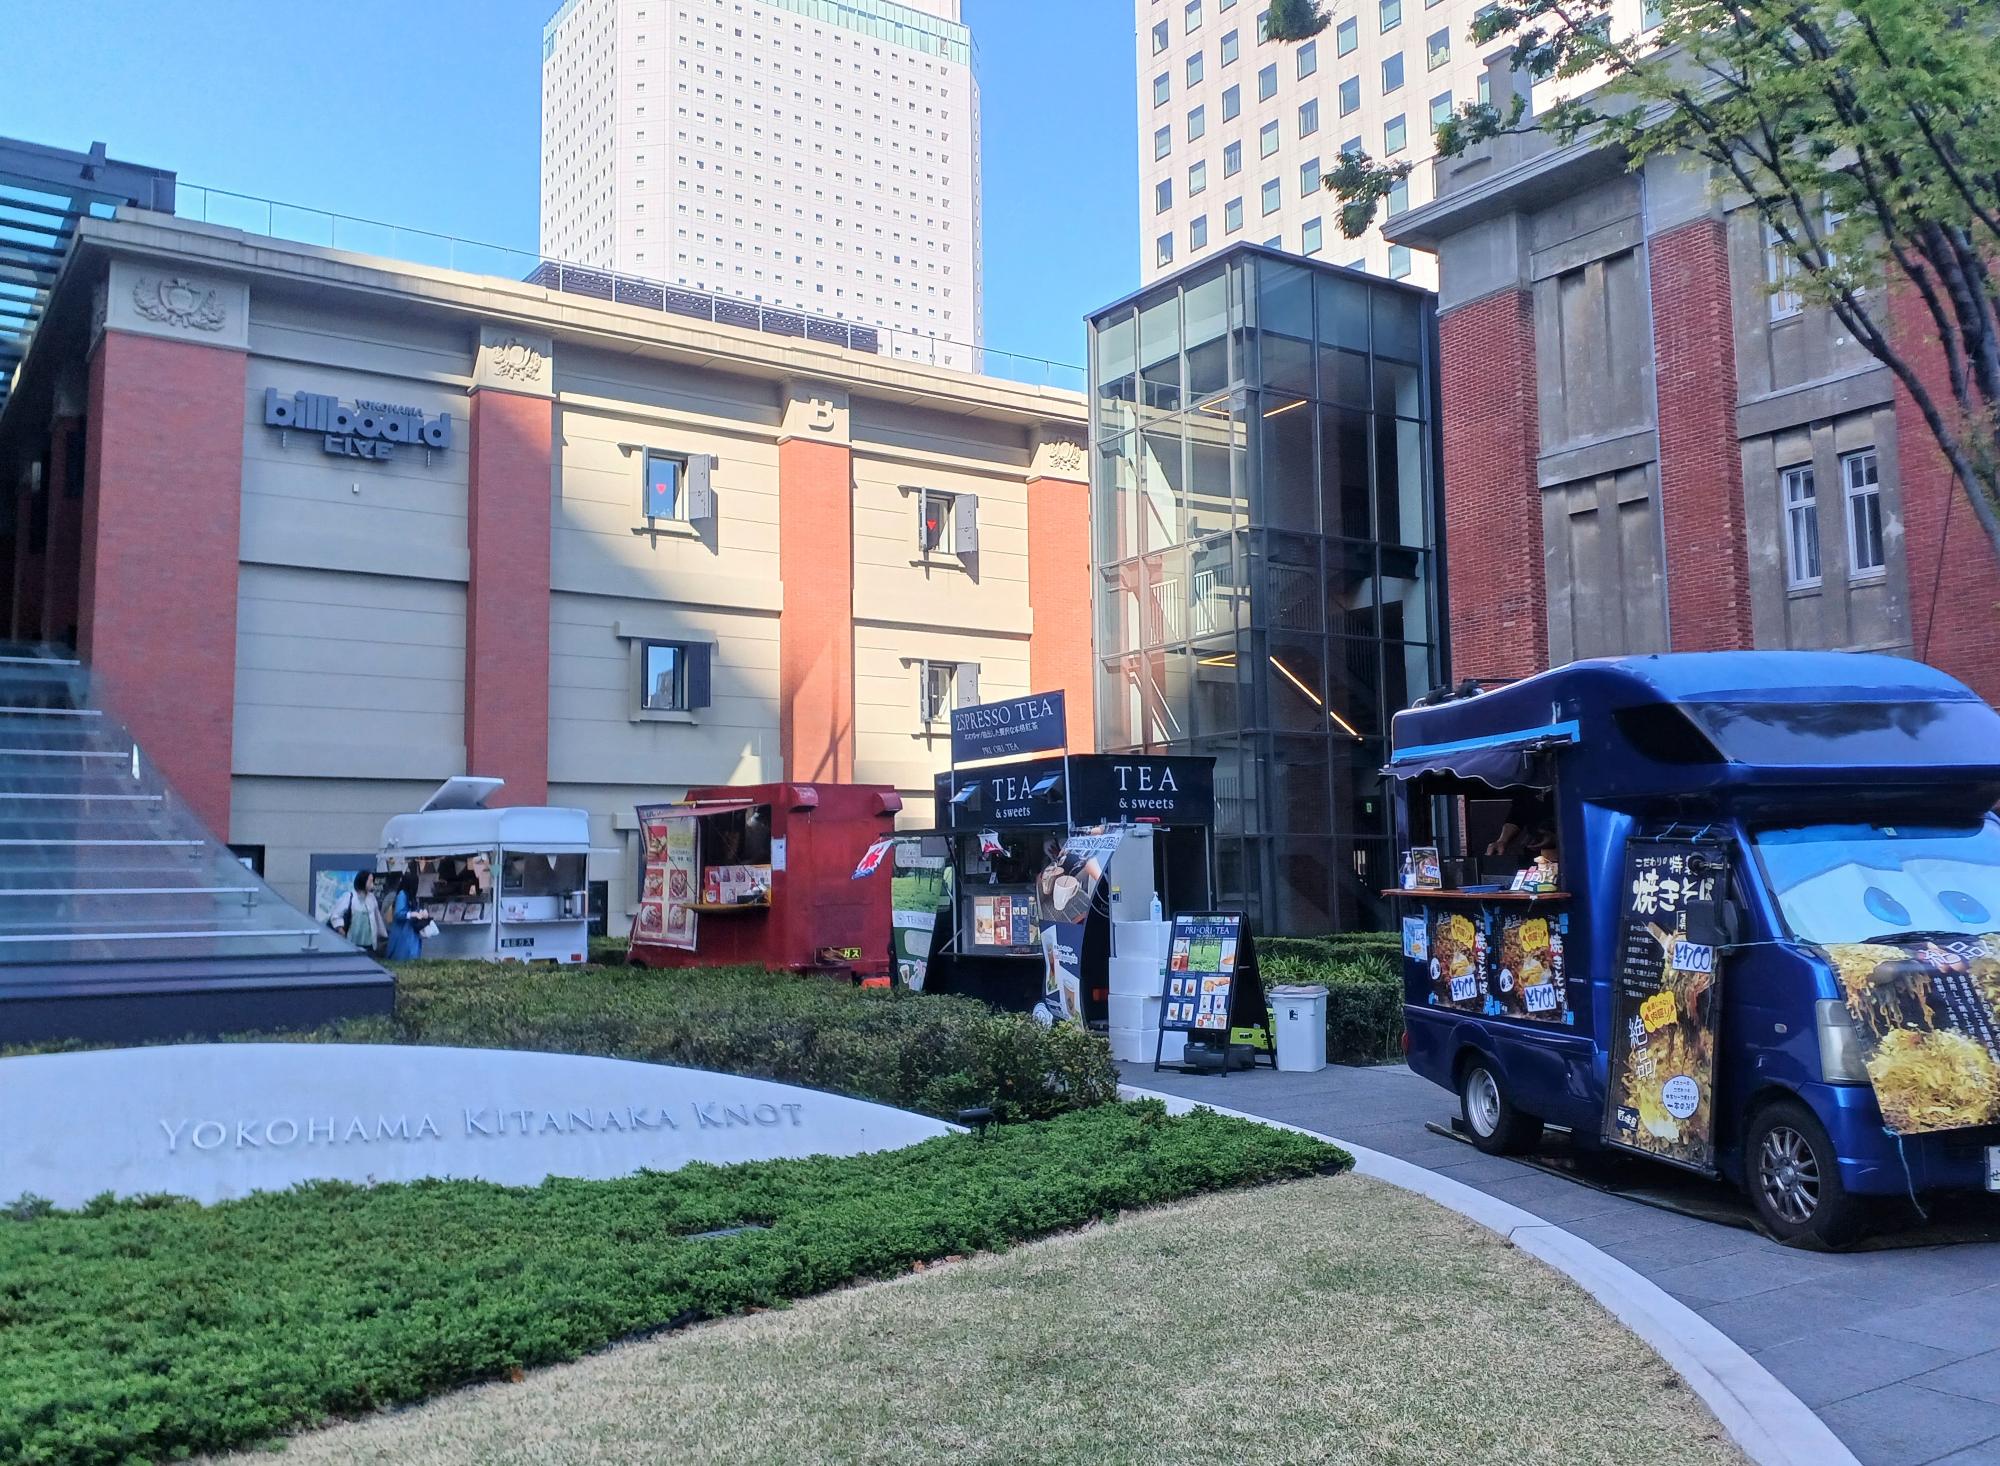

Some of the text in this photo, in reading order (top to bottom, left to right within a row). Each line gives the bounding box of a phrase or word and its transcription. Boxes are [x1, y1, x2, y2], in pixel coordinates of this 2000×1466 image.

[264, 386, 451, 448] billboard
[324, 434, 394, 460] LIVE
[956, 698, 1053, 731] ESPRESSO TEA
[1005, 741, 1020, 752] TEA
[992, 776, 1033, 802] TEA
[1114, 766, 1179, 791] TEA
[995, 806, 1031, 819] & sweets
[1119, 798, 1174, 809] & sweets
[1632, 868, 1715, 915] 焼きそば
[1550, 933, 1564, 1003] 焼きそば
[1674, 945, 1711, 970] ¥700
[1451, 974, 1476, 999] ¥700
[1526, 986, 1556, 1009] ¥700
[159, 1101, 804, 1153] YOKOHAMA KITANAKA KNOT
